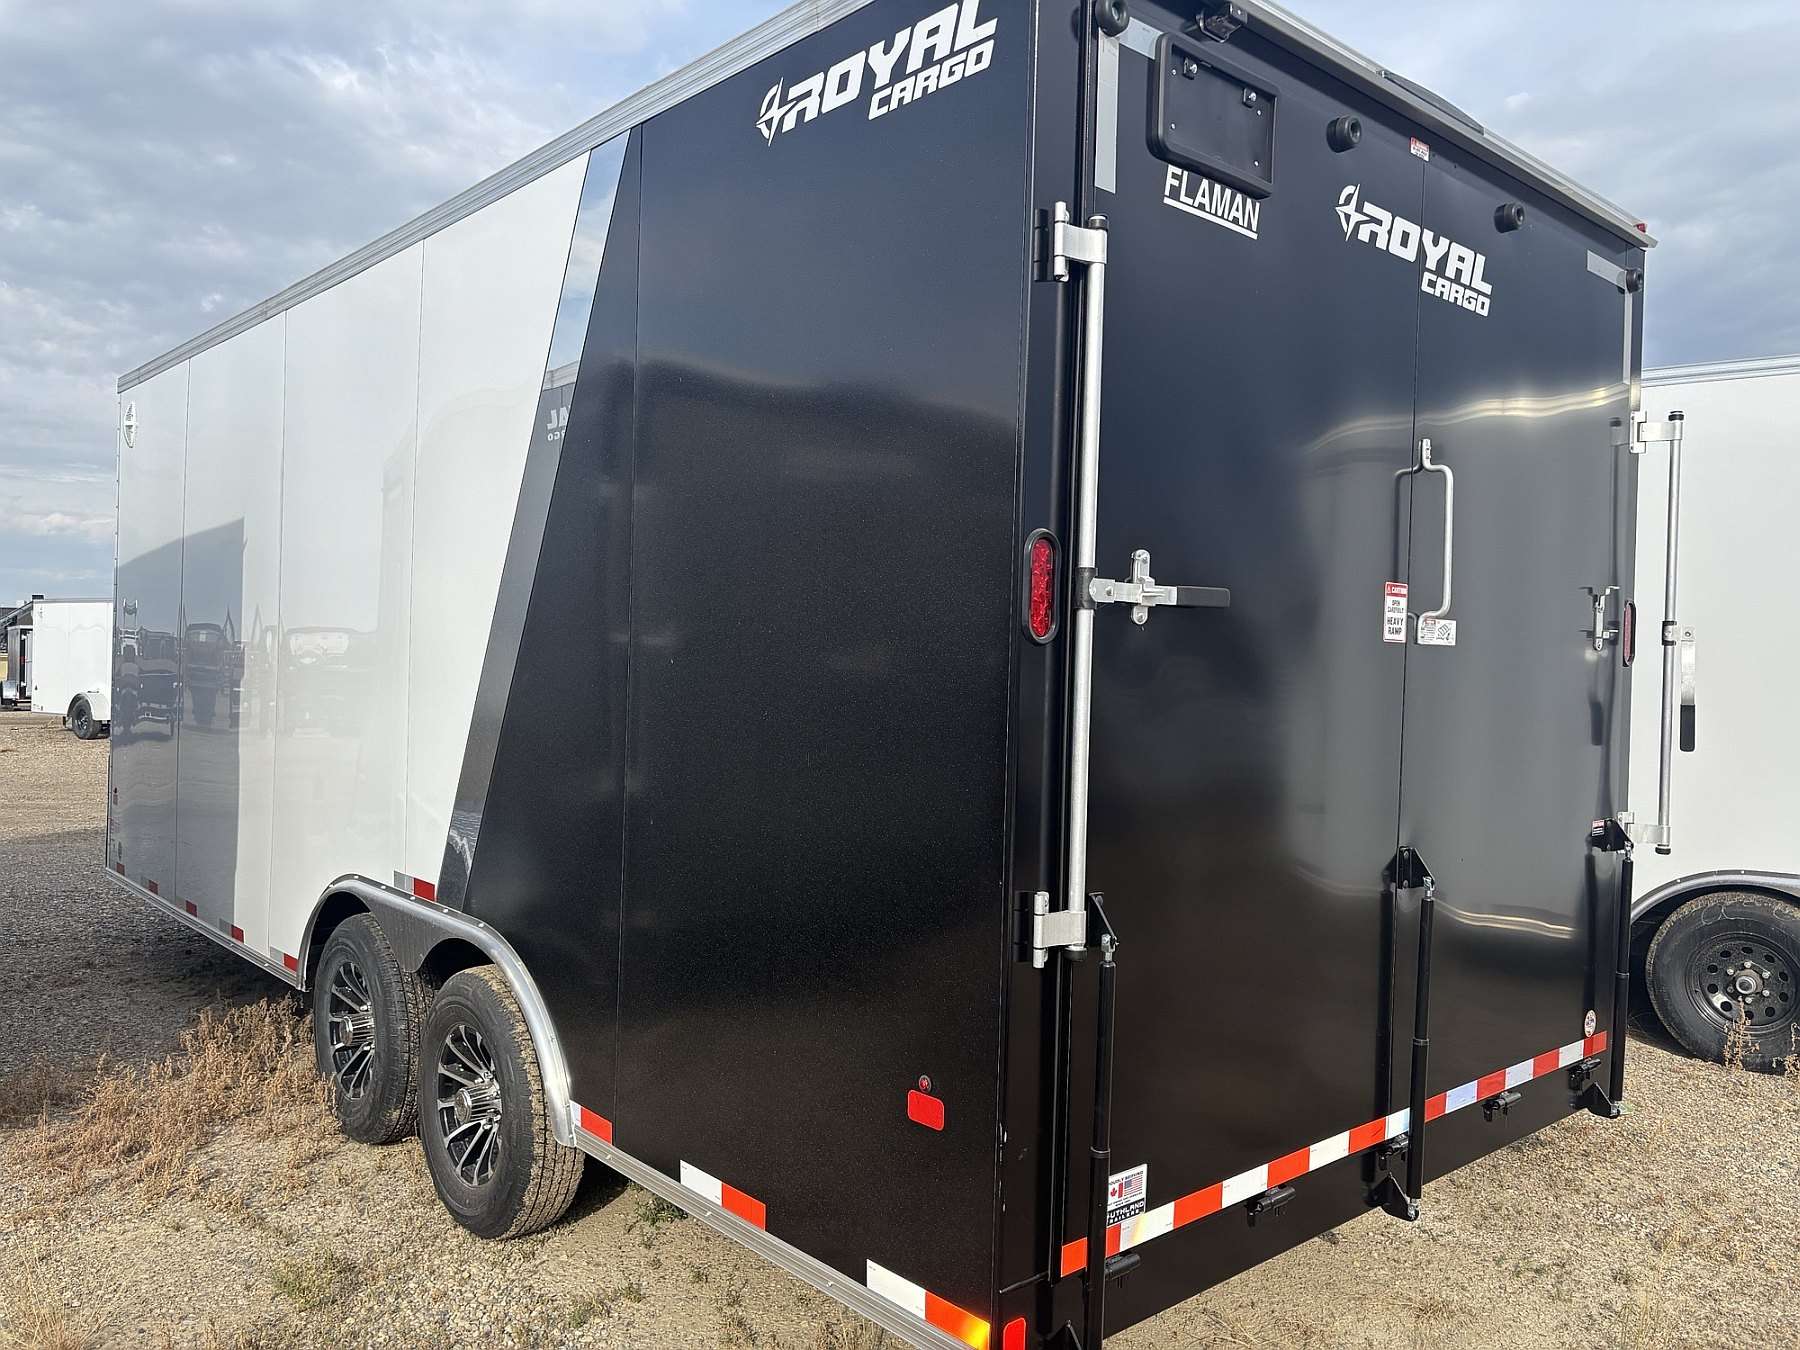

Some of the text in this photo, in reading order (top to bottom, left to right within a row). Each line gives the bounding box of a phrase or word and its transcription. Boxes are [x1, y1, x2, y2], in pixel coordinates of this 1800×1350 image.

[782, 0, 998, 133] ROYAL
[868, 39, 995, 120] CARGO
[1164, 164, 1260, 232] FLAMAN
[1357, 201, 1492, 295] ROYAL
[1421, 271, 1491, 317] CARGO
[1387, 617, 1404, 625] HEAVY
[1387, 627, 1402, 635] RAMP
